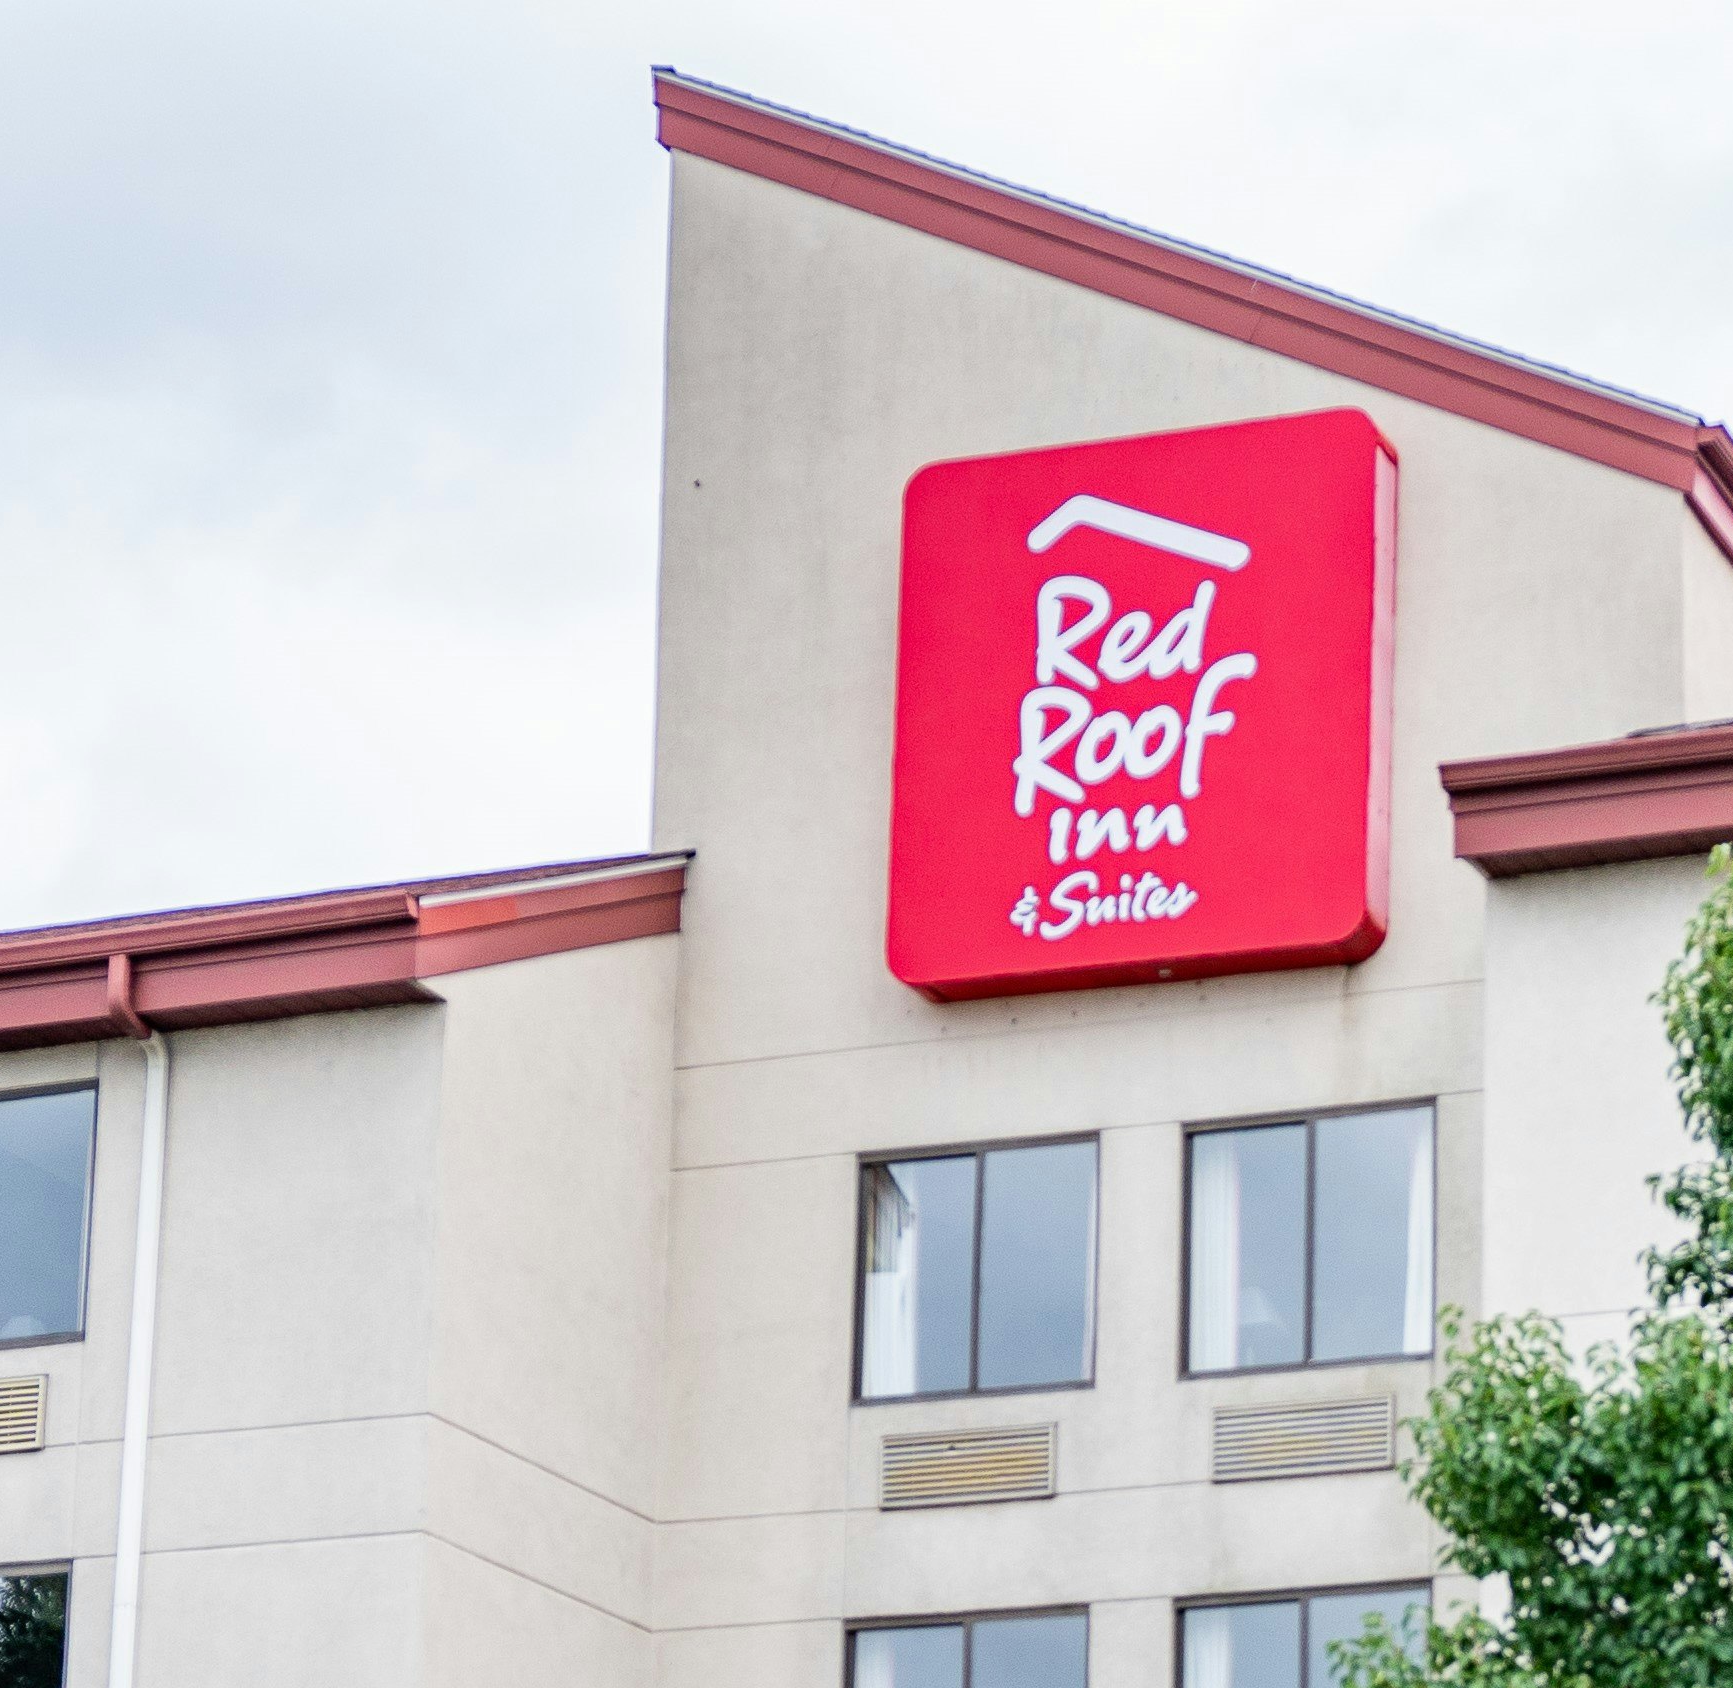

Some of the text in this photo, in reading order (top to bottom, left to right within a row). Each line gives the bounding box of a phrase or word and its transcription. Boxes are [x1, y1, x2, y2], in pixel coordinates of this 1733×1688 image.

[1036, 575, 1216, 691] Red
[1013, 652, 1257, 817] Roof
[1009, 870, 1199, 941] & Suites
